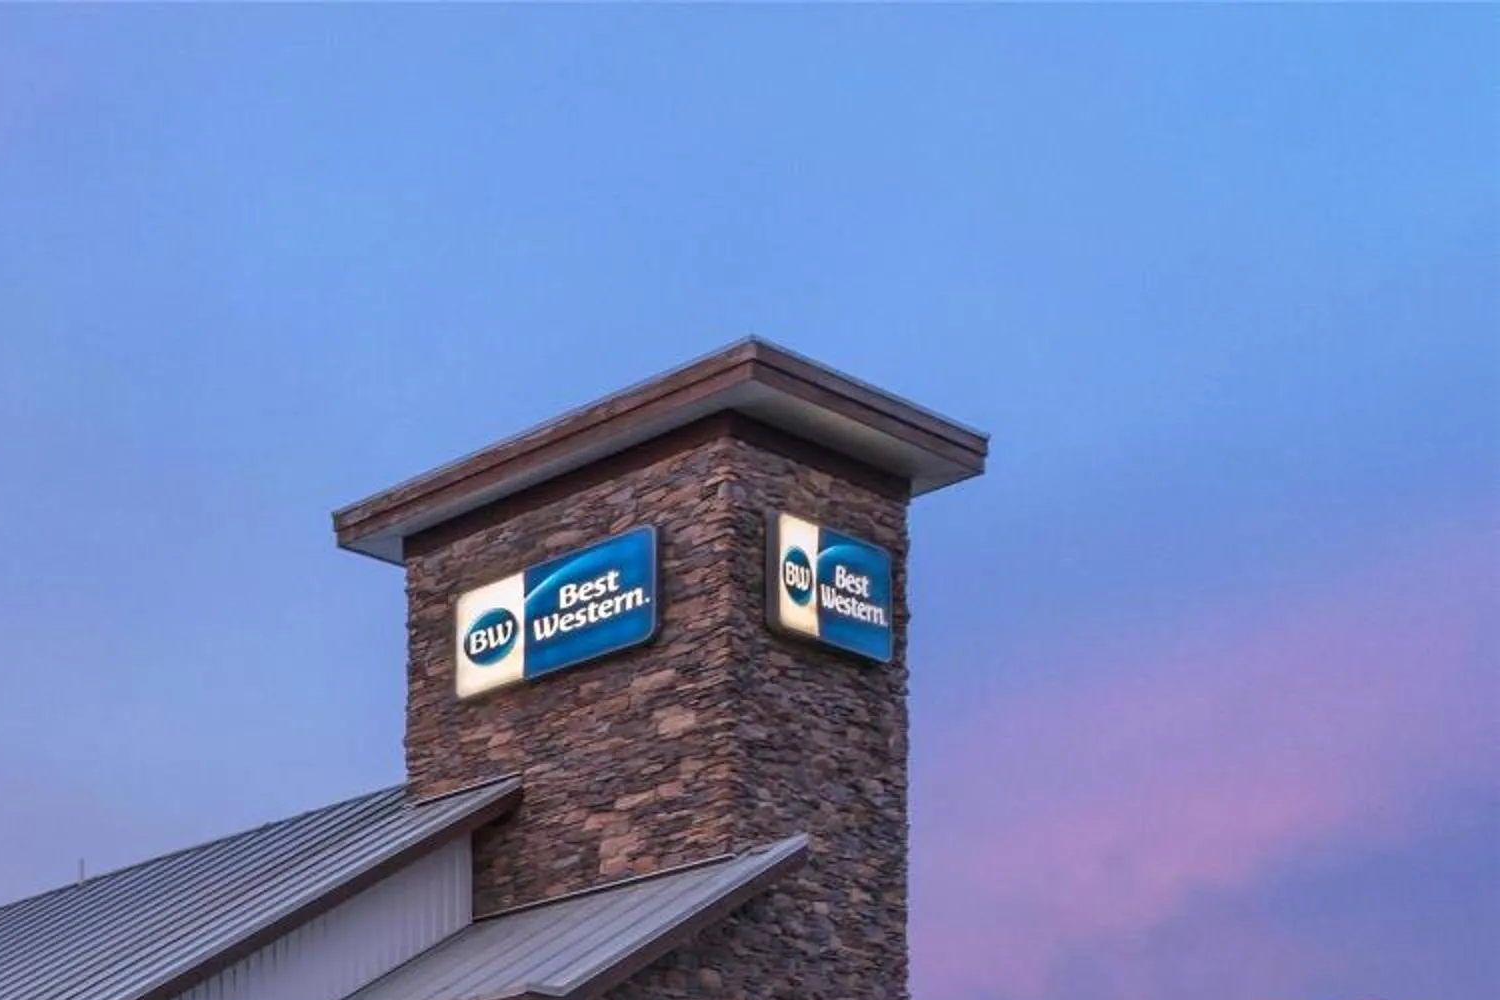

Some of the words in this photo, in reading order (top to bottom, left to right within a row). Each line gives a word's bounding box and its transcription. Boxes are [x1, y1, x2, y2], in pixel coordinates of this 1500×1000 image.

[560, 569, 619, 610] Best
[785, 560, 811, 591] BW
[835, 565, 869, 598] Best
[469, 619, 514, 655] BW
